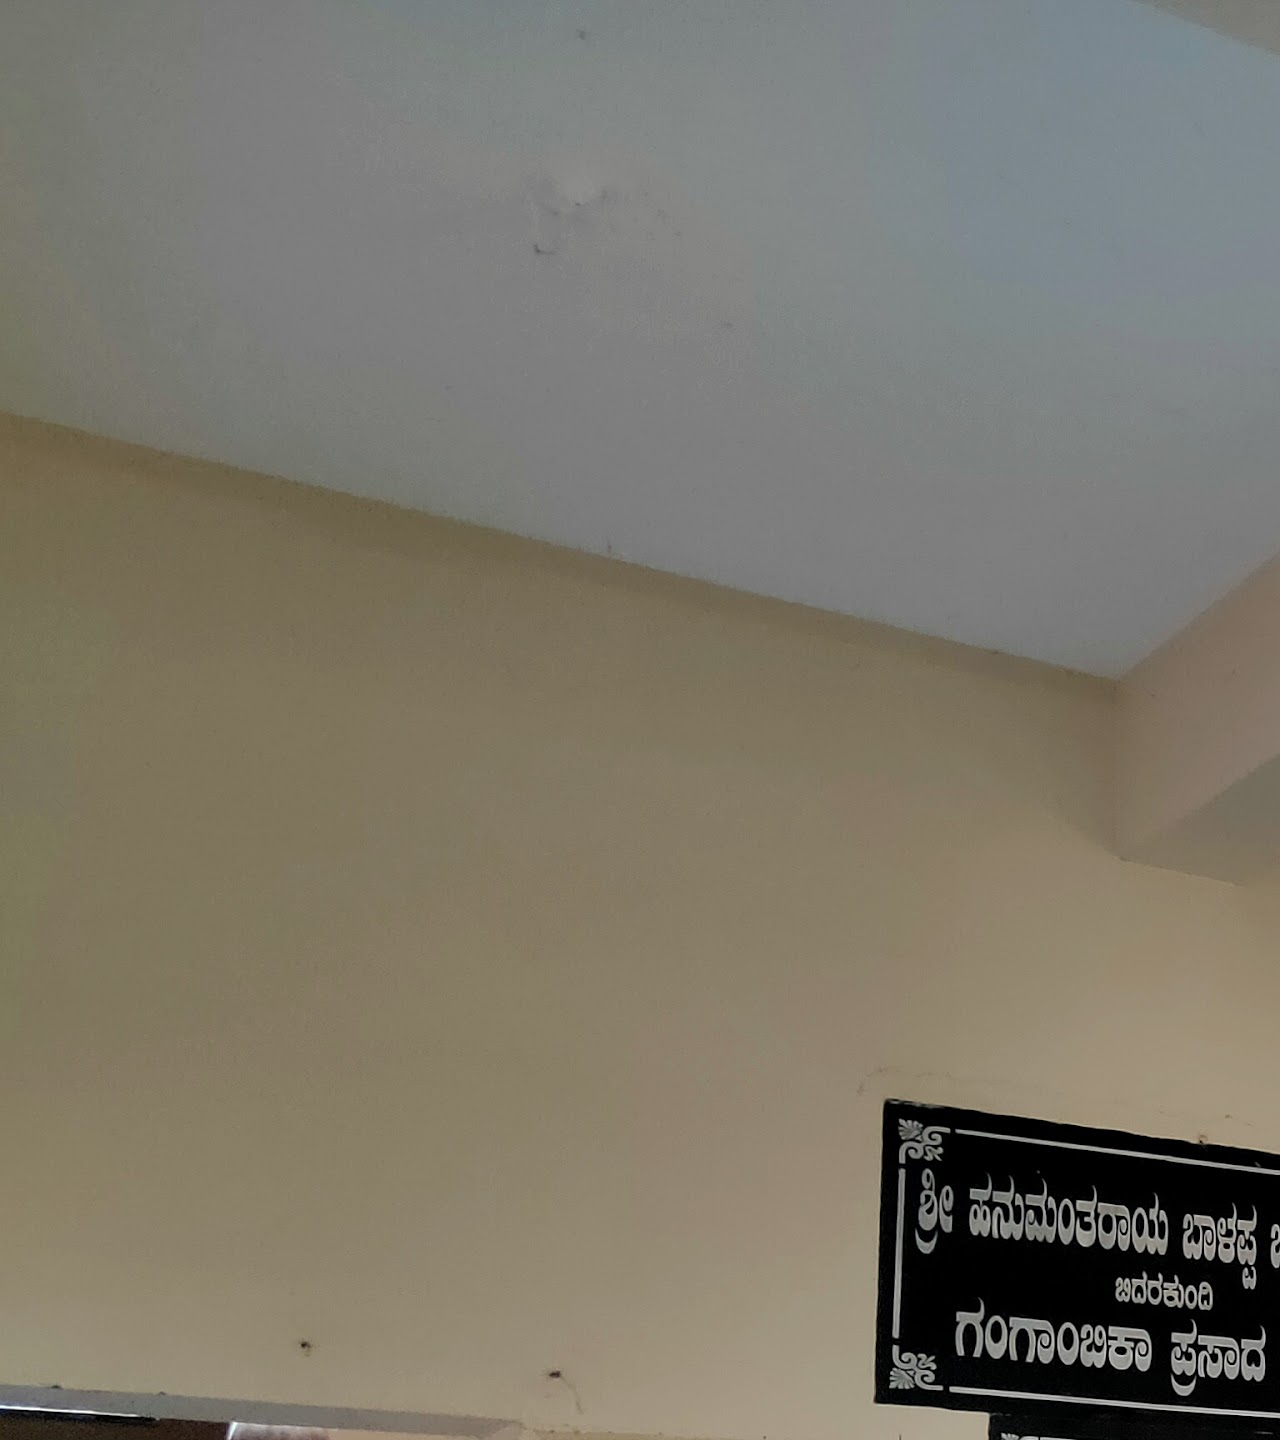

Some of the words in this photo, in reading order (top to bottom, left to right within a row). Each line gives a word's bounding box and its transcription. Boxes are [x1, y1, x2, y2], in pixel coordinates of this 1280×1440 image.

[915, 1169, 954, 1254] ಶ್ರೀ
[969, 1174, 1168, 1256] ಹನುಮಂತರಾಯ
[1183, 1203, 1258, 1290] ಬಾಳಪ್ಪ
[1116, 1271, 1213, 1311] ಬಿದರಕುಂದಿ
[956, 1298, 1153, 1372] ಗಂಗಾಂಬಿಕಾ
[1171, 1319, 1266, 1396] ಪ್ರಸಾದ
